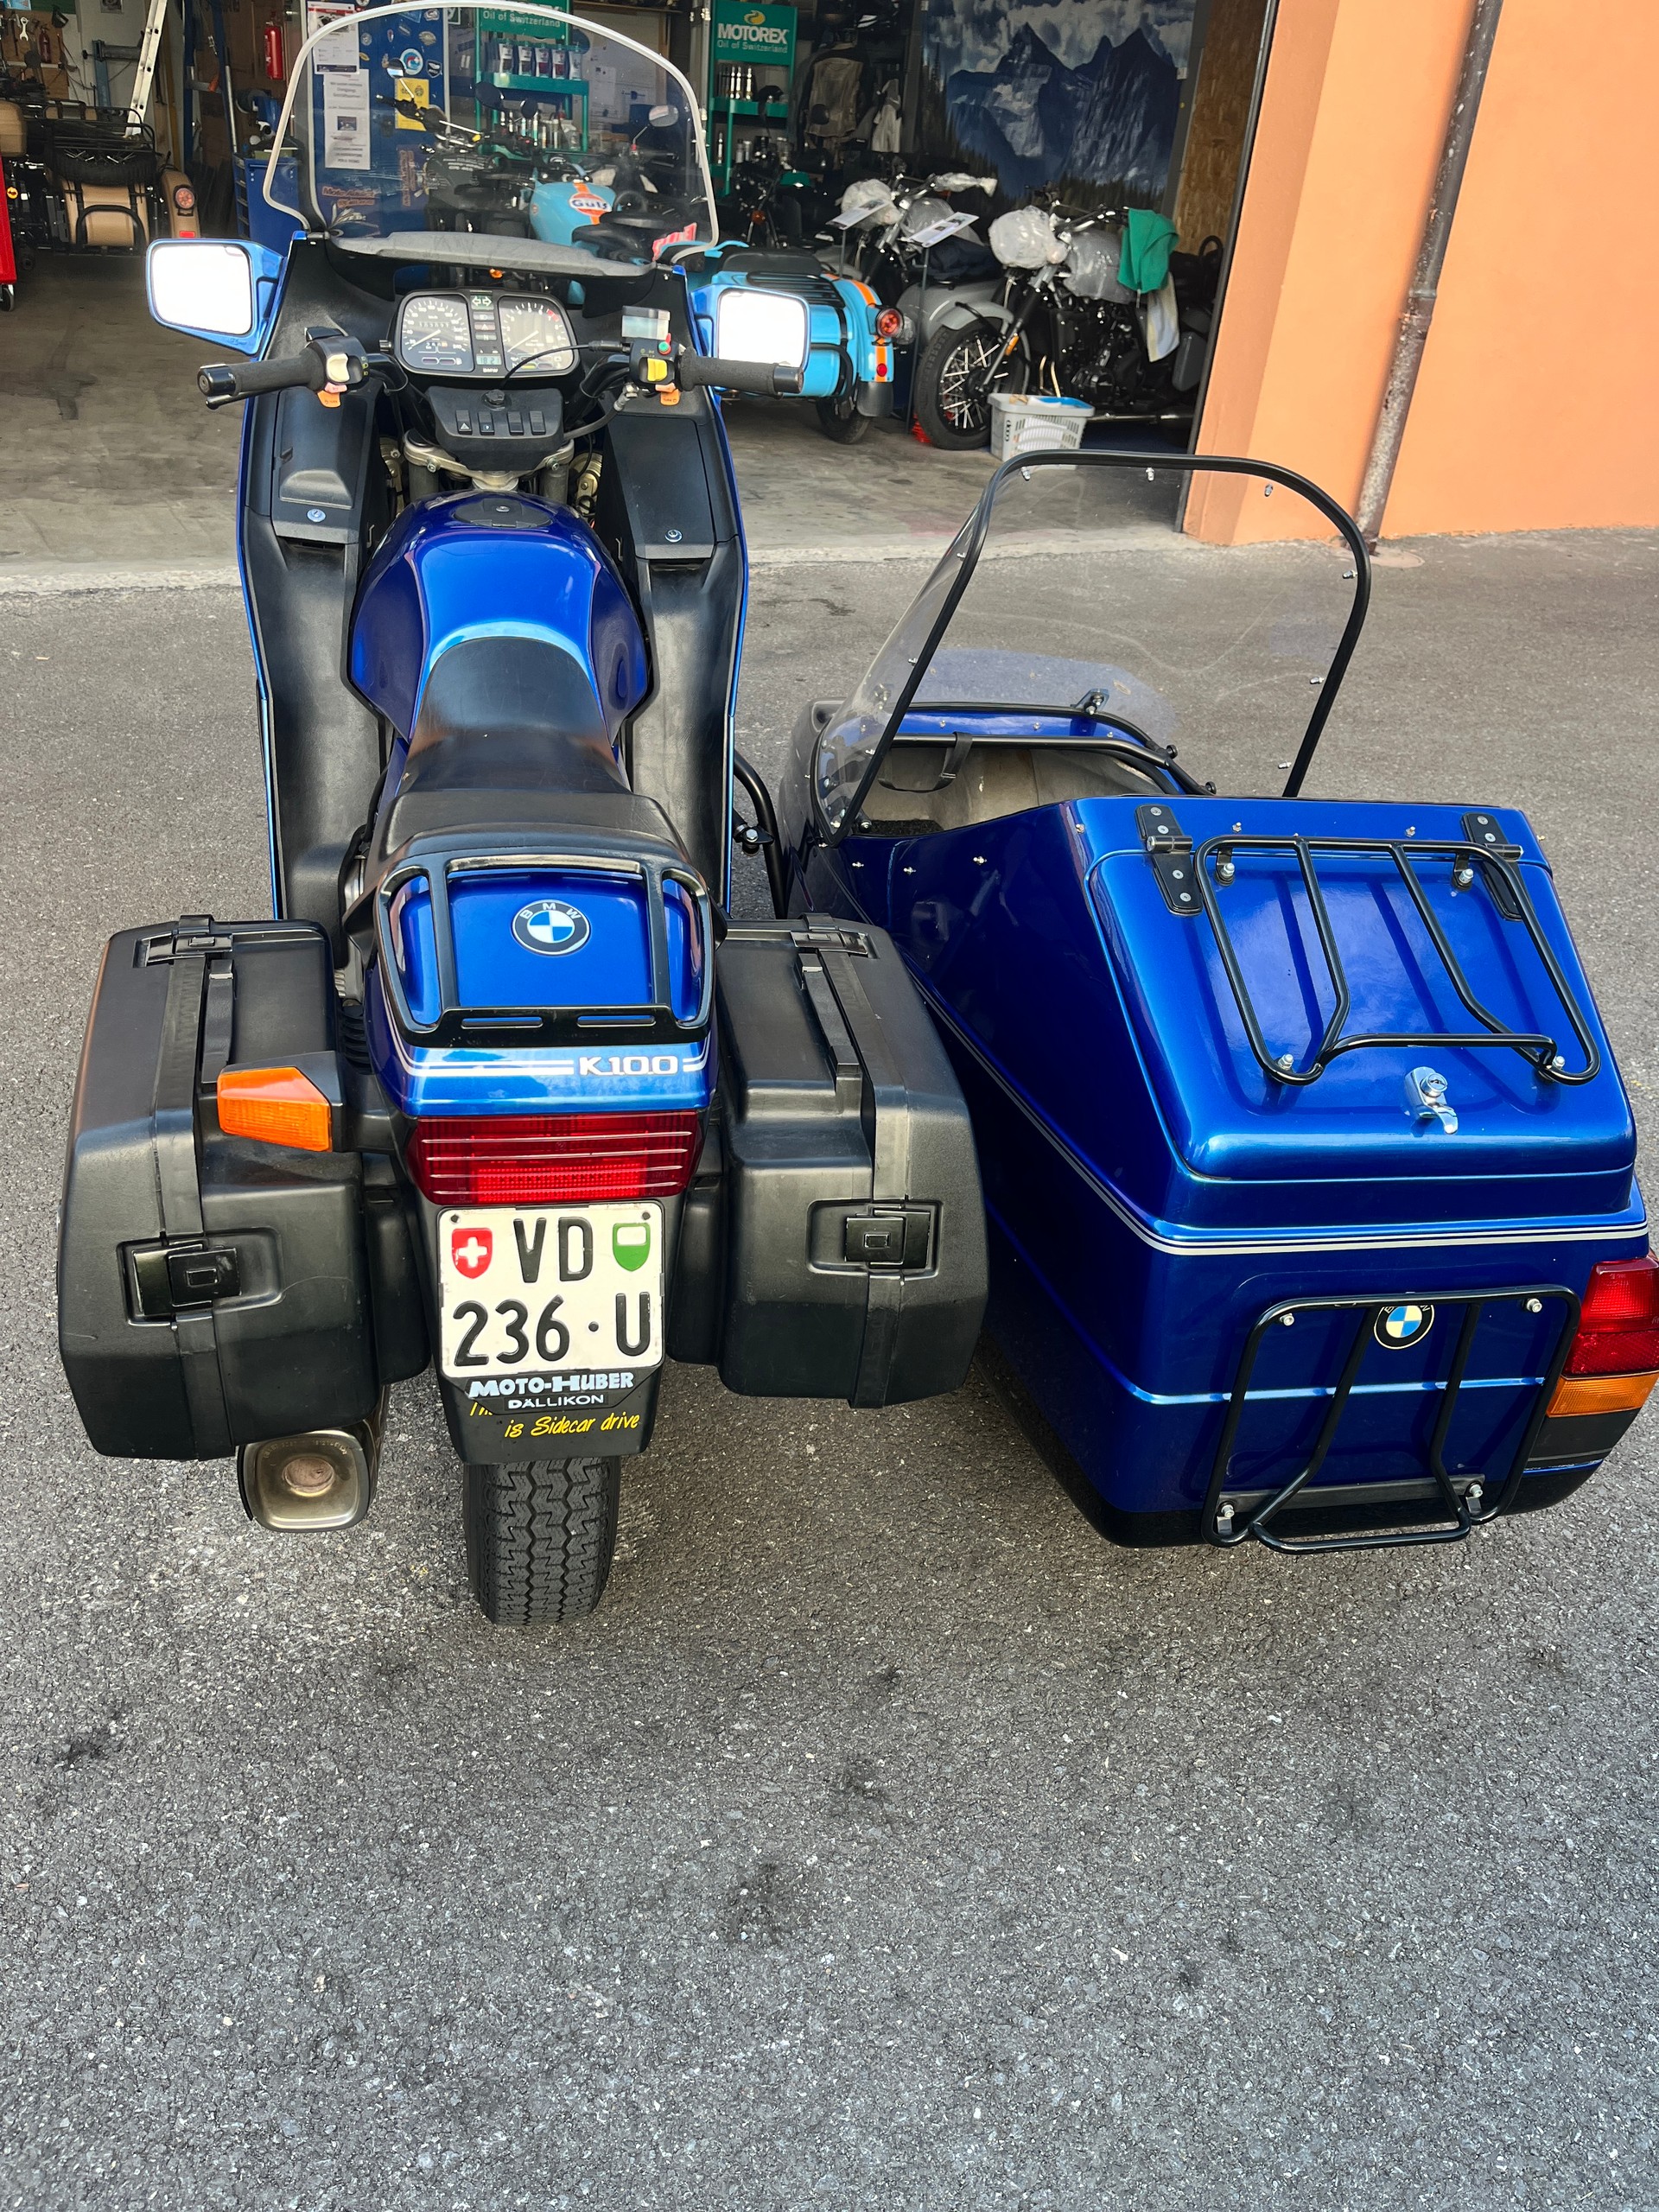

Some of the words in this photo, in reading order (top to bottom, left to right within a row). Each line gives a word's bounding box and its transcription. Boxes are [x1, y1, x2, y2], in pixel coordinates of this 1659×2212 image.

[483, 10, 495, 20] Oil
[498, 12, 507, 22] of
[510, 13, 561, 28] Switzerland
[718, 22, 788, 44] MOTOREX
[717, 40, 728, 48] Oil
[519, 902, 582, 919] BMW
[579, 1056, 678, 1076] K100
[513, 1217, 594, 1283] VD
[468, 1372, 634, 1398] MOTO-HUBER
[508, 1394, 604, 1409] DÄLLIKON
[505, 1420, 524, 1439] is
[530, 1415, 596, 1436] Sidecar
[601, 1411, 640, 1432] drive
